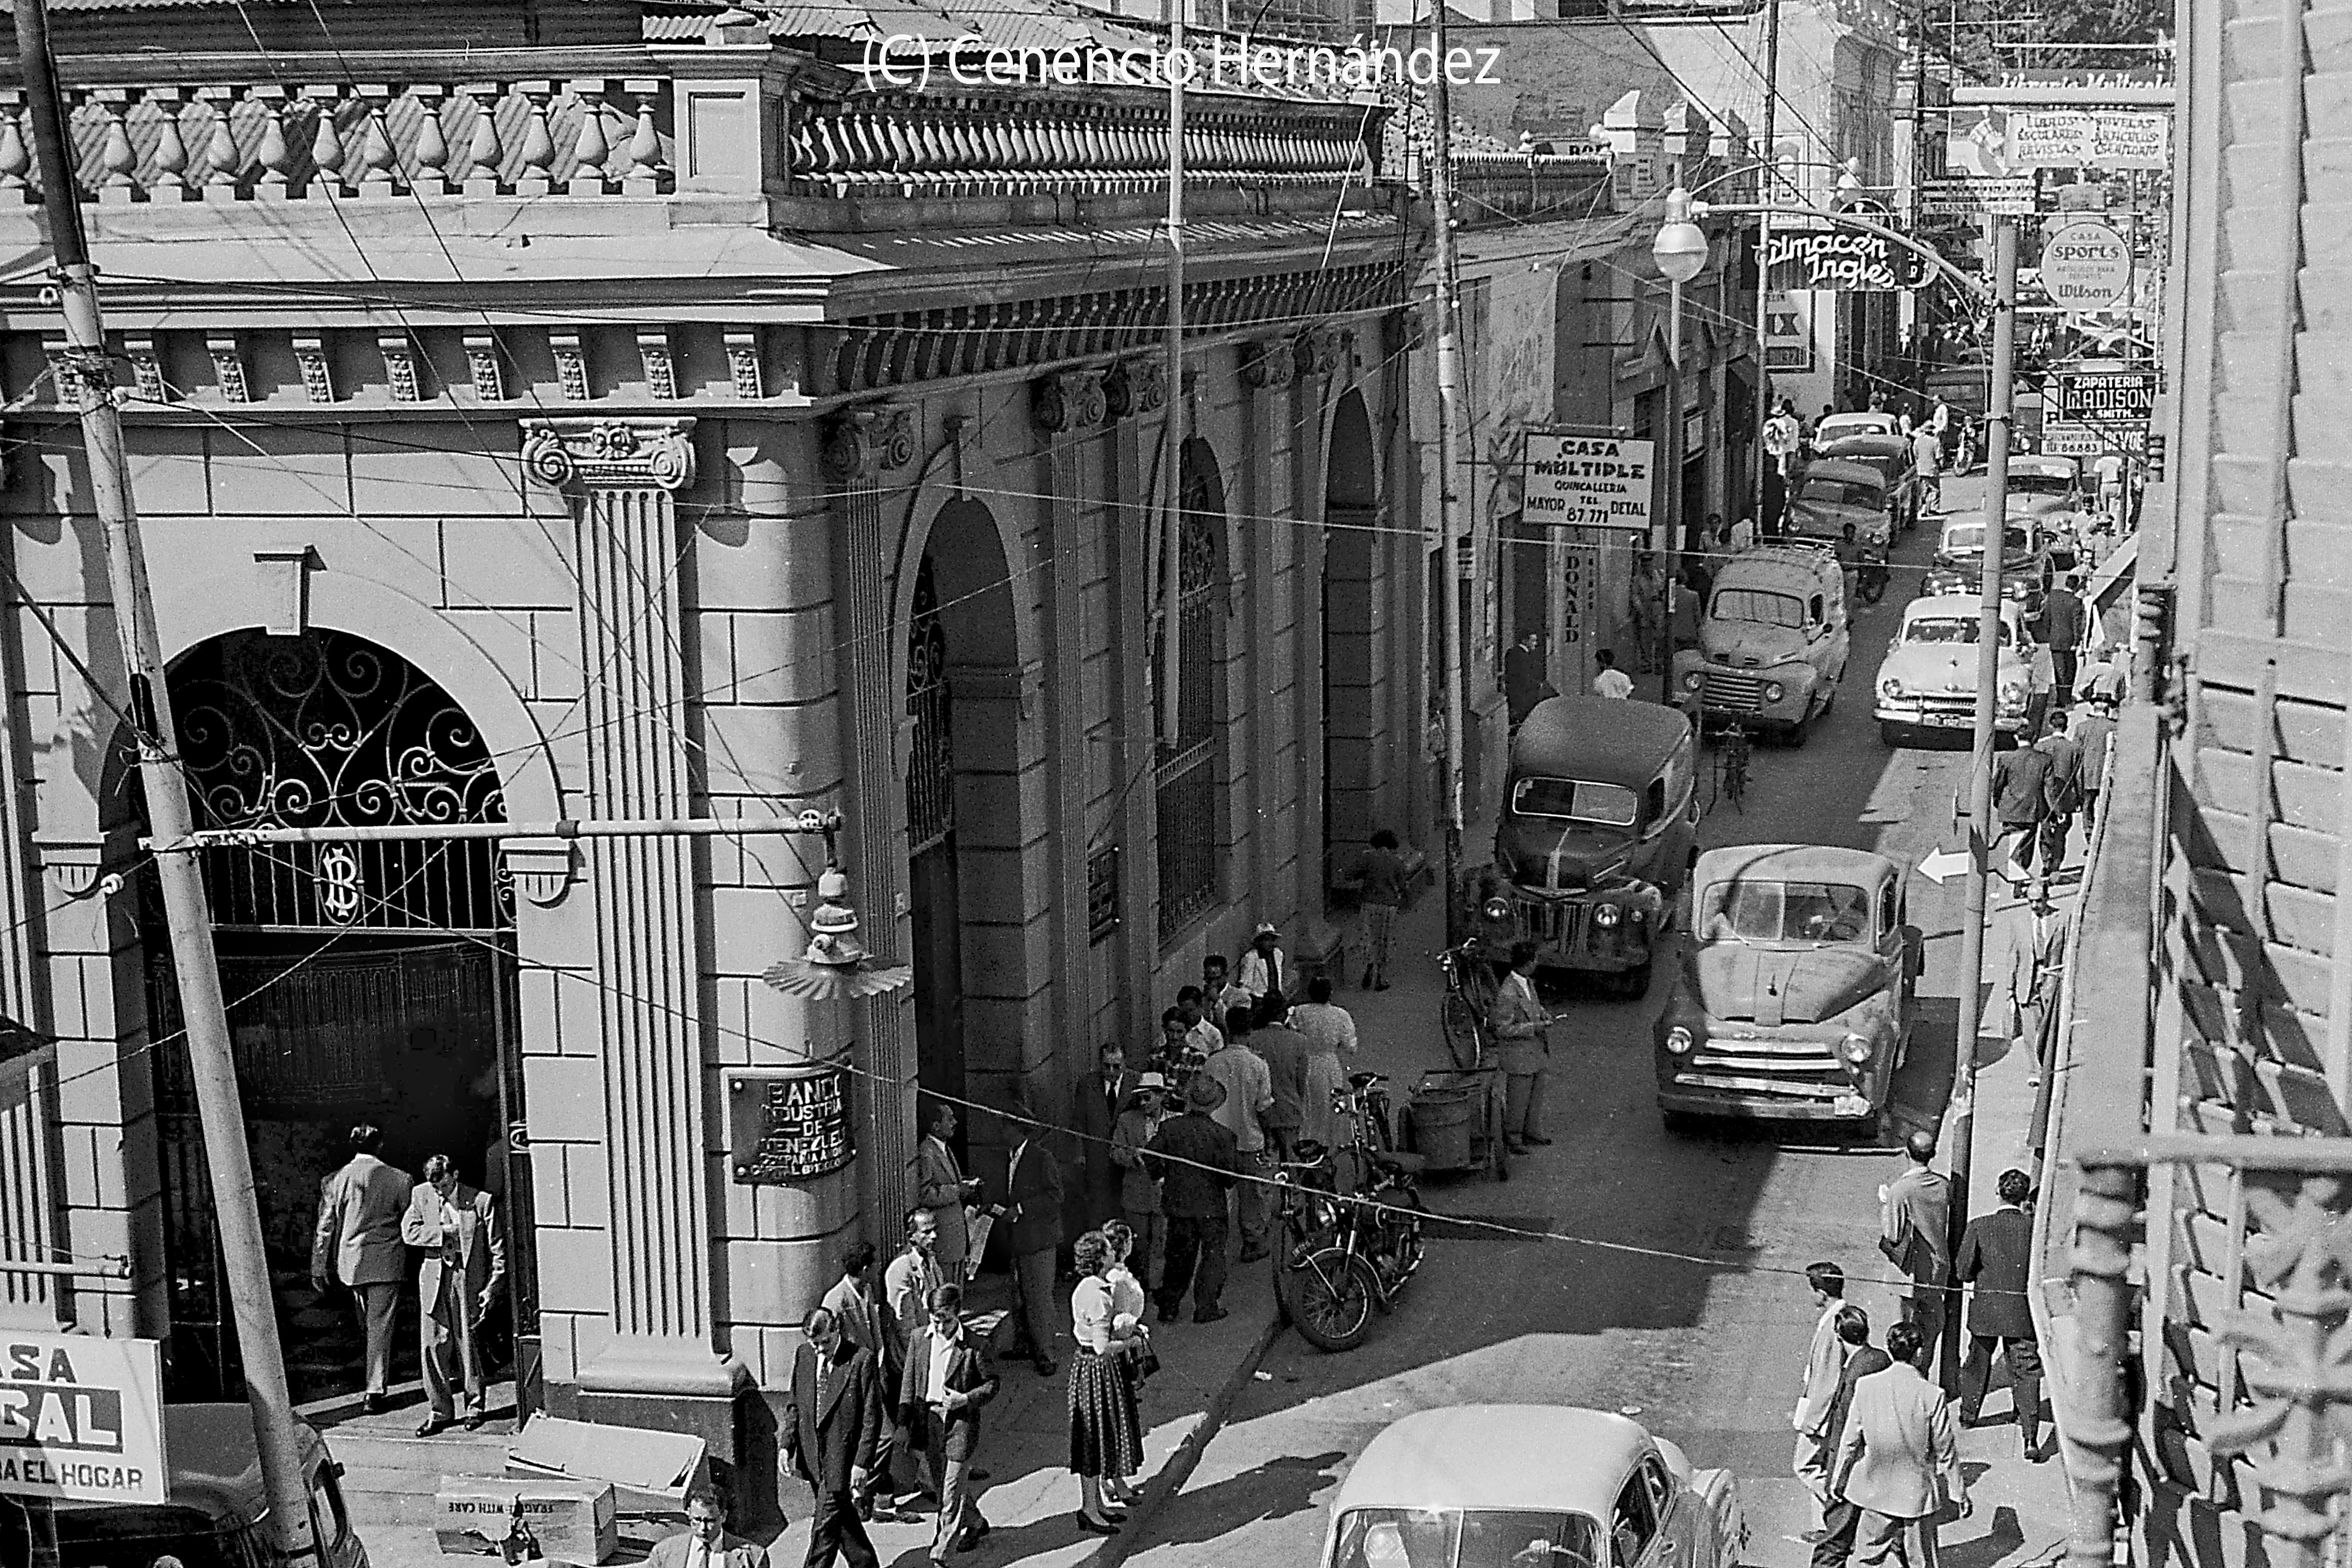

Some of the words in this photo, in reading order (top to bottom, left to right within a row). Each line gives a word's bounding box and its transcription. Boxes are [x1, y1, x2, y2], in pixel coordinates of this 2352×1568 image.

[2027, 115, 2078, 127] LIBROS
[2058, 284, 2112, 298] Wilson
[2074, 377, 2143, 389] ZAPATERIA
[2067, 389, 2153, 410] MADISON
[1561, 440, 1619, 457] CASA
[1527, 496, 1566, 511] MAYOR
[1610, 501, 1646, 516] DETAL
[803, 1118, 826, 1136] DE
[0, 1344, 77, 1383] SA
[23, 1460, 56, 1484] EL
[61, 1463, 143, 1491] HOGAR
[449, 1502, 476, 1513] CARE
[479, 1503, 503, 1513] WITH
